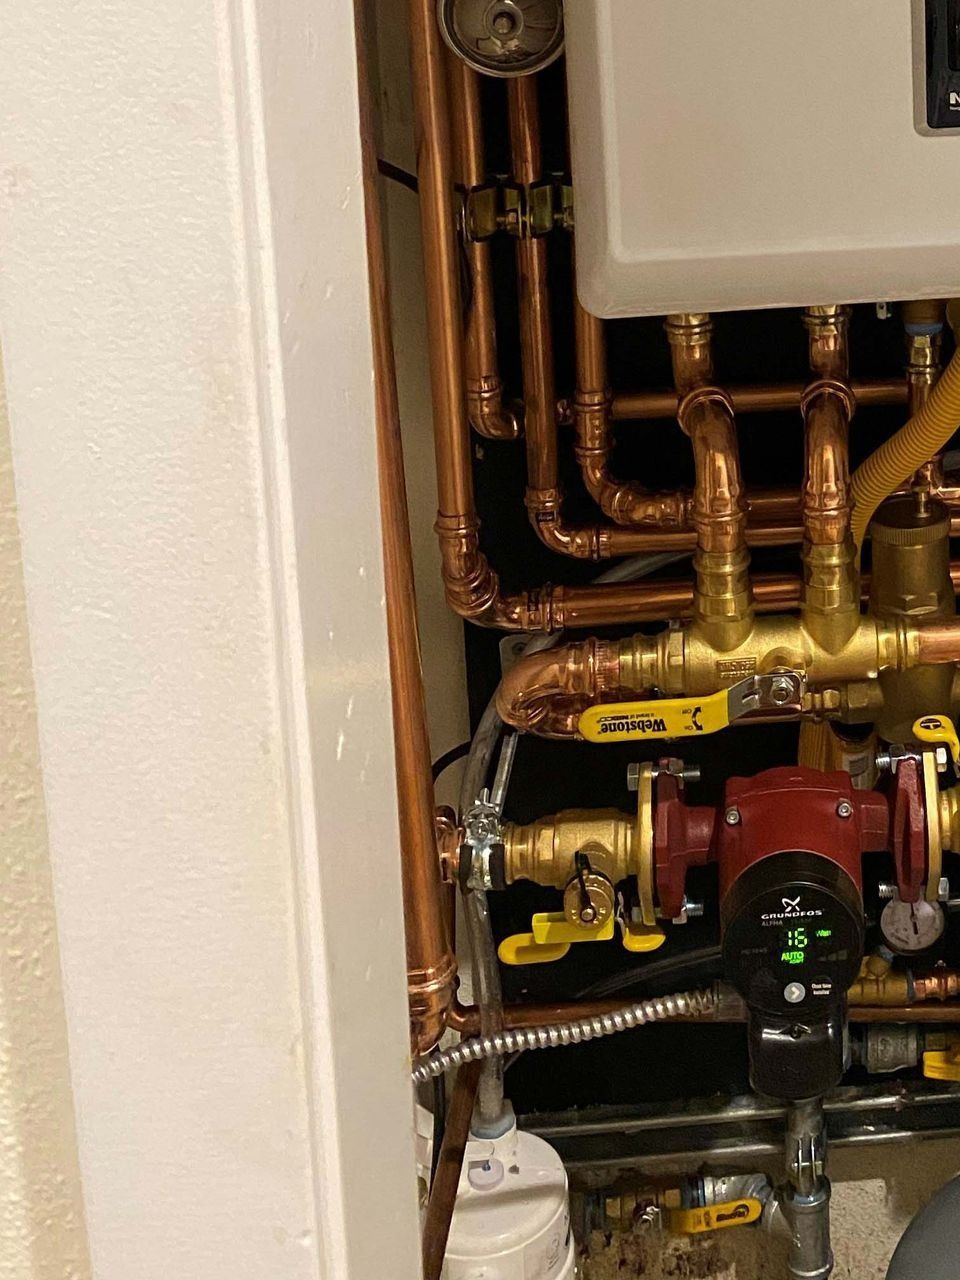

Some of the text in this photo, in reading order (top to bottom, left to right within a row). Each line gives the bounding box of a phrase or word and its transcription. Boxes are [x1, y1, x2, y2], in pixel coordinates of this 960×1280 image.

[600, 718, 667, 734] Webstone
[761, 910, 822, 920] GRUNDFOS
[788, 927, 807, 947] 16
[781, 951, 804, 961] AUTO
